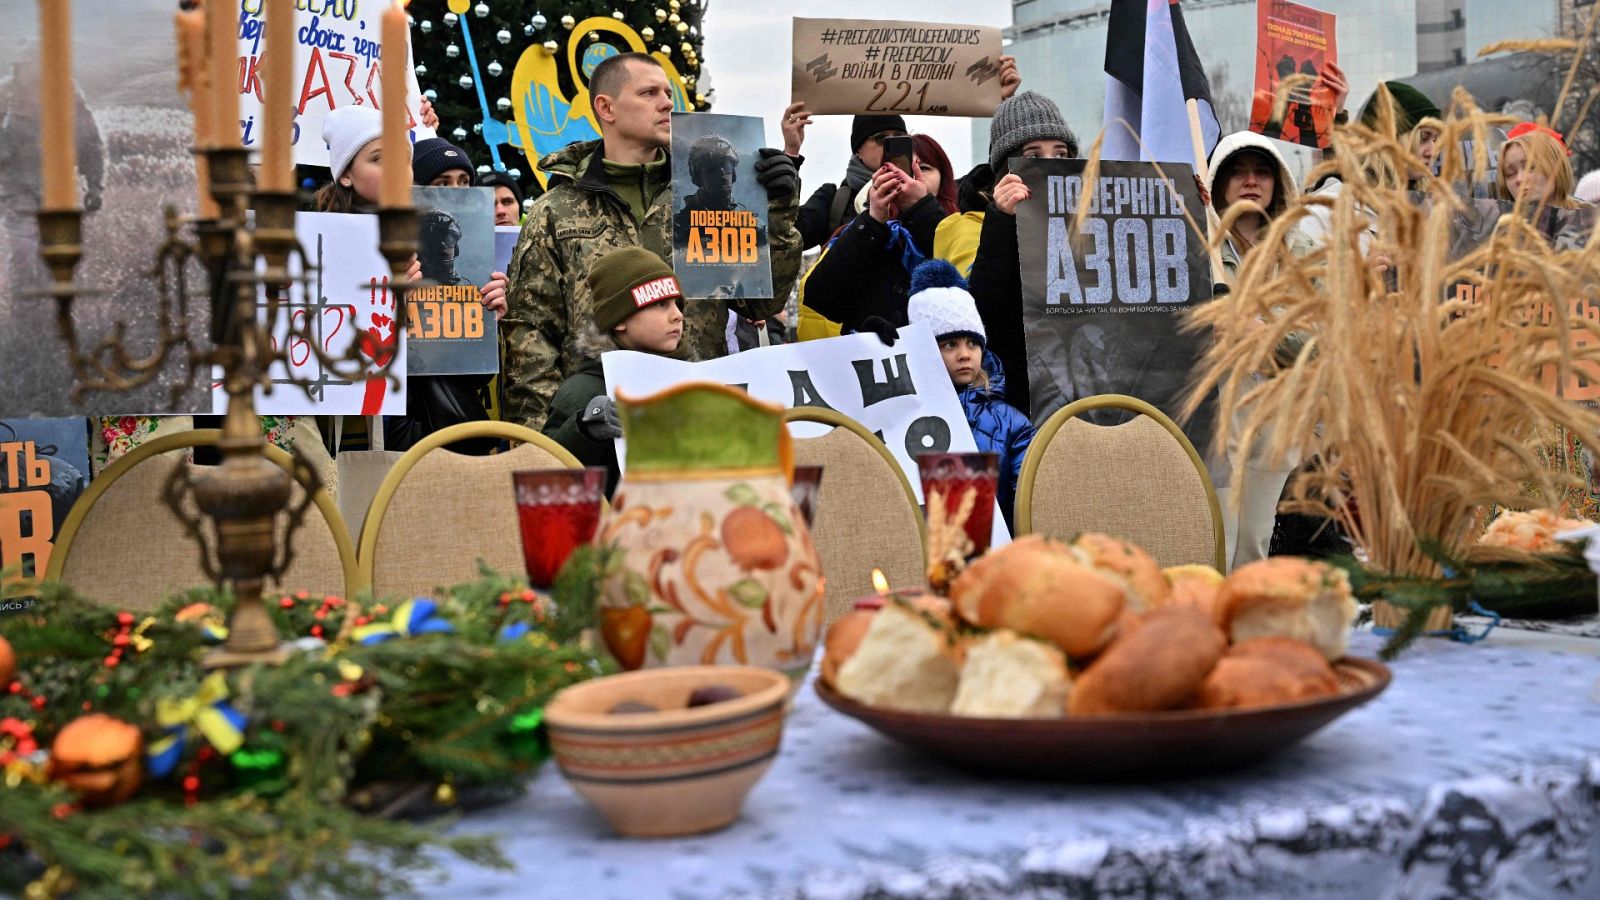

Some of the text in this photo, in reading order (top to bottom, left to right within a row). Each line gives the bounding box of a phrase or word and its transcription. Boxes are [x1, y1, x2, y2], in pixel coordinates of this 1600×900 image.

[298, 16, 345, 52] своїх
[821, 28, 980, 45] #FREEAZOVSTALDEFENDERS
[842, 61, 957, 81] ВОЇНИ В ПОЛОНІ
[865, 80, 930, 112] 221
[691, 210, 757, 227] ПОВЕРНІТЬ
[686, 227, 759, 264] АЗОВ
[1046, 217, 1190, 305] АЗОВ
[632, 277, 680, 306] MARVEL
[407, 302, 484, 338] АЗОВ
